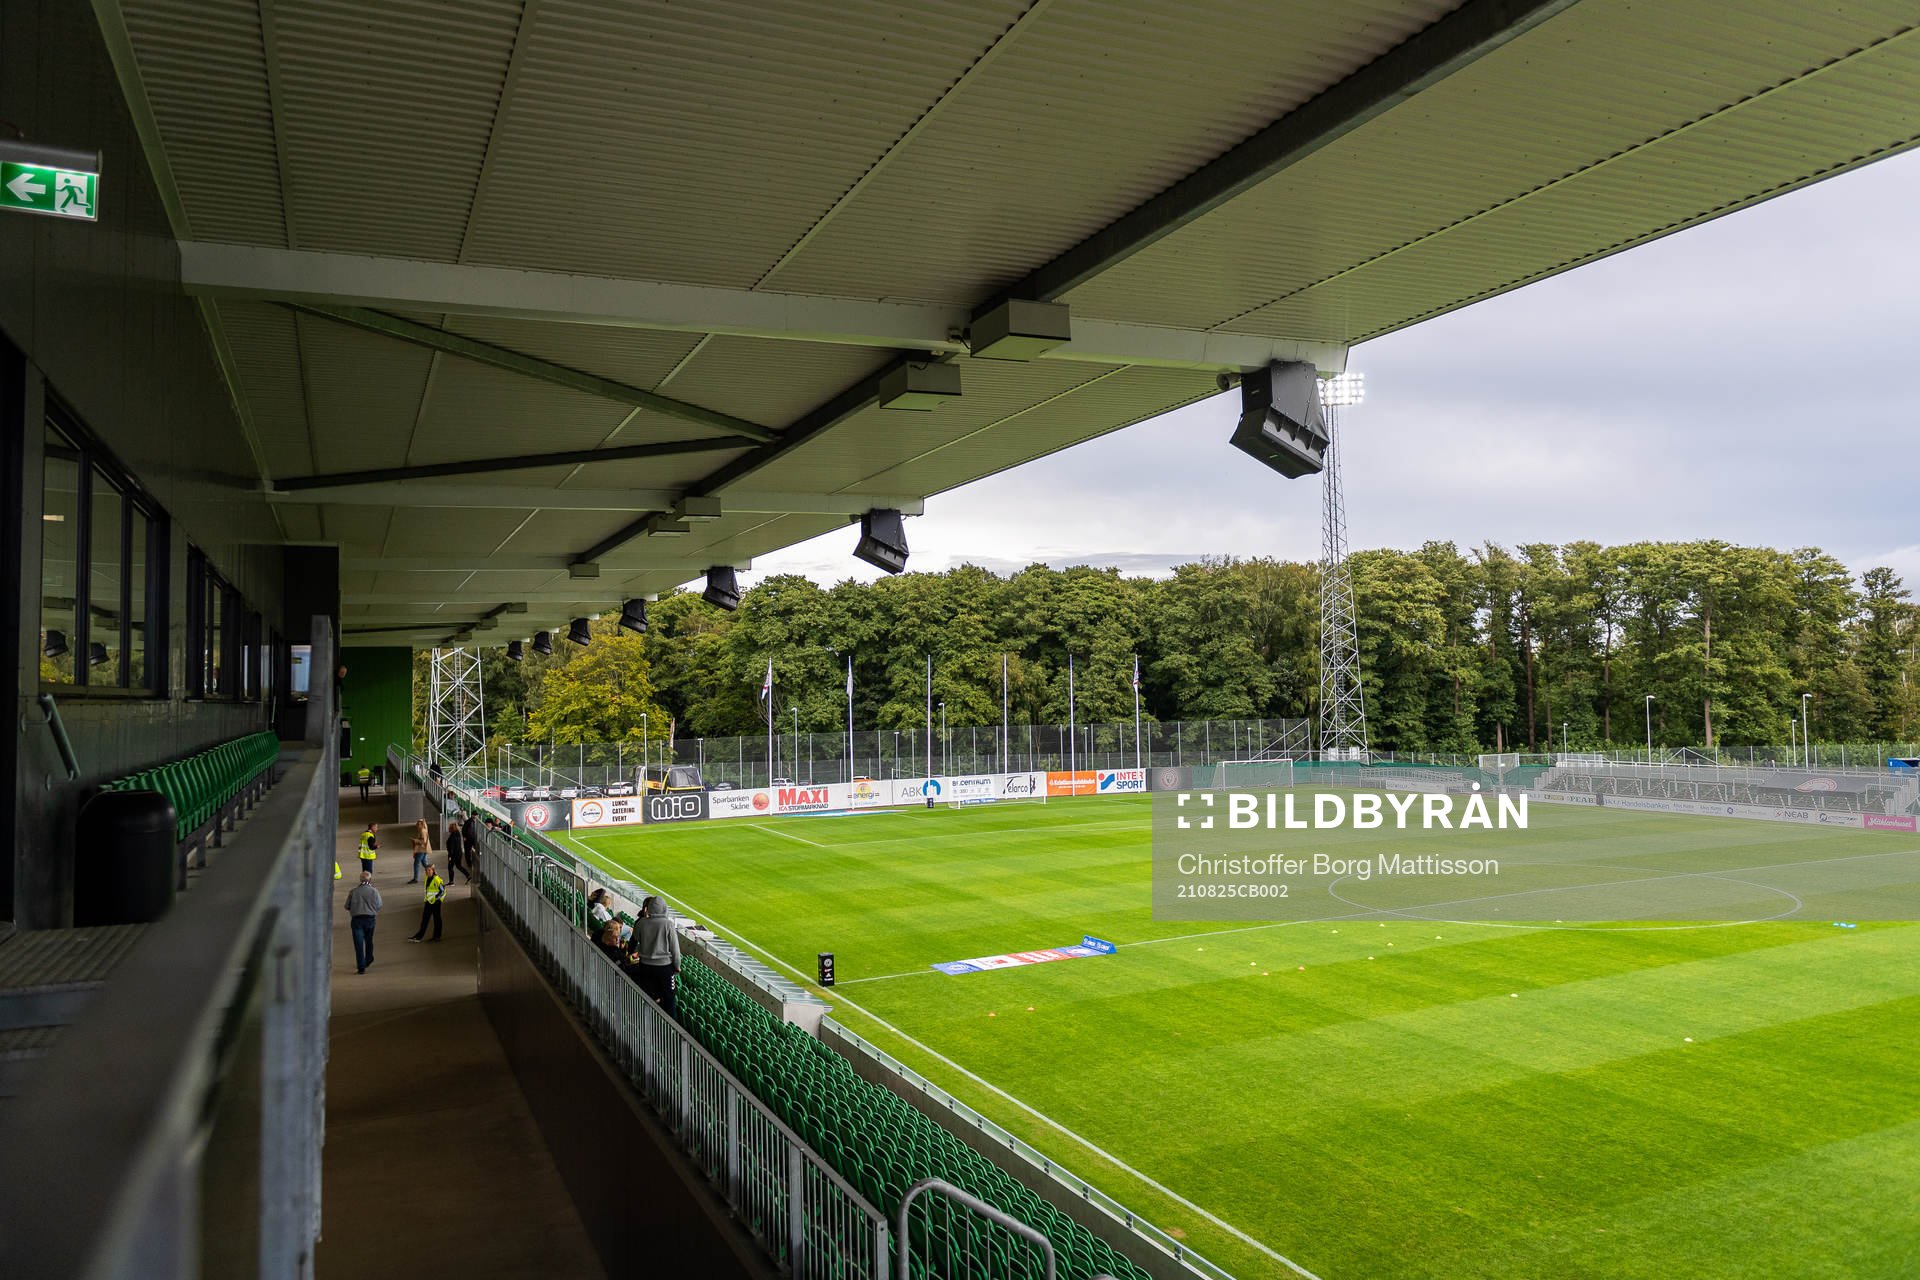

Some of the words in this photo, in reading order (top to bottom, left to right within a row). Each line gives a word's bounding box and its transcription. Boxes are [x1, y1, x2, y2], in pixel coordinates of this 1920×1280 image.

[1116, 772, 1144, 780] INTER
[1117, 780, 1144, 789] SPORT
[901, 786, 922, 797] ABK
[713, 795, 750, 805] Sparbanken
[778, 788, 829, 805] MAXI
[1570, 795, 1594, 804] PEAB
[731, 802, 750, 811] Skåne
[788, 803, 829, 811] STORMARKNAD
[1621, 800, 1670, 809] Handelsbanken
[612, 807, 635, 815] CATERING
[1784, 810, 1809, 819] NEAB
